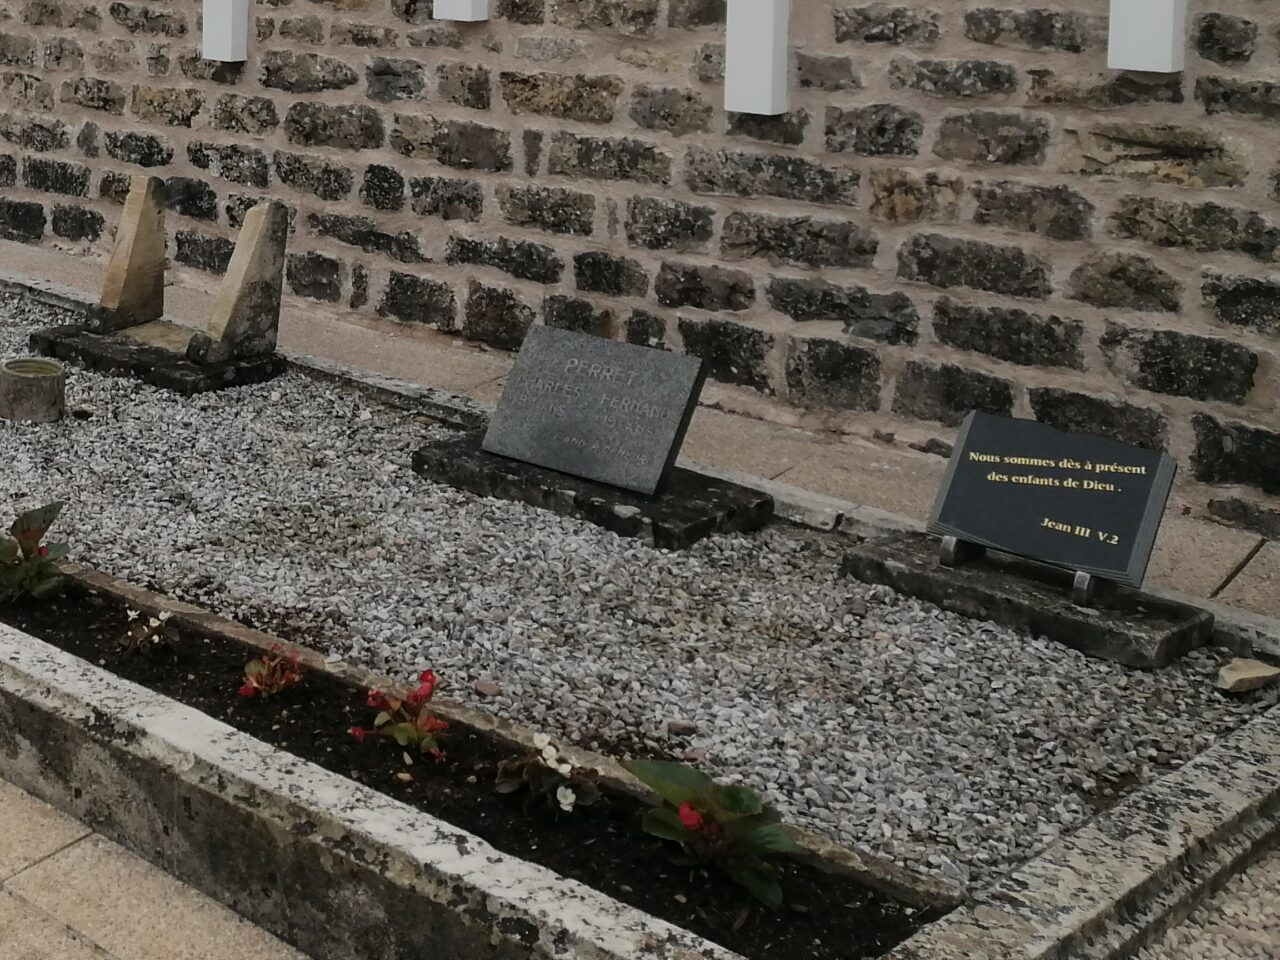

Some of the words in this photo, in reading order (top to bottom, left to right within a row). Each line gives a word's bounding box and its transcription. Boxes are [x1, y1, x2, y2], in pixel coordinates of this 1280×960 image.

[563, 357, 639, 387] PERRET
[600, 393, 671, 420] FERNAND
[969, 451, 1001, 464] Nous
[1003, 456, 1056, 468] sommes
[1058, 458, 1082, 470] dès
[1084, 460, 1093, 471] à
[1094, 462, 1147, 476] présent
[986, 471, 1009, 483] des
[1011, 474, 1060, 487] enfants
[1063, 477, 1080, 489] de
[1082, 479, 1115, 492] Dieu
[1039, 517, 1072, 534] Jean
[1073, 526, 1092, 539] III
